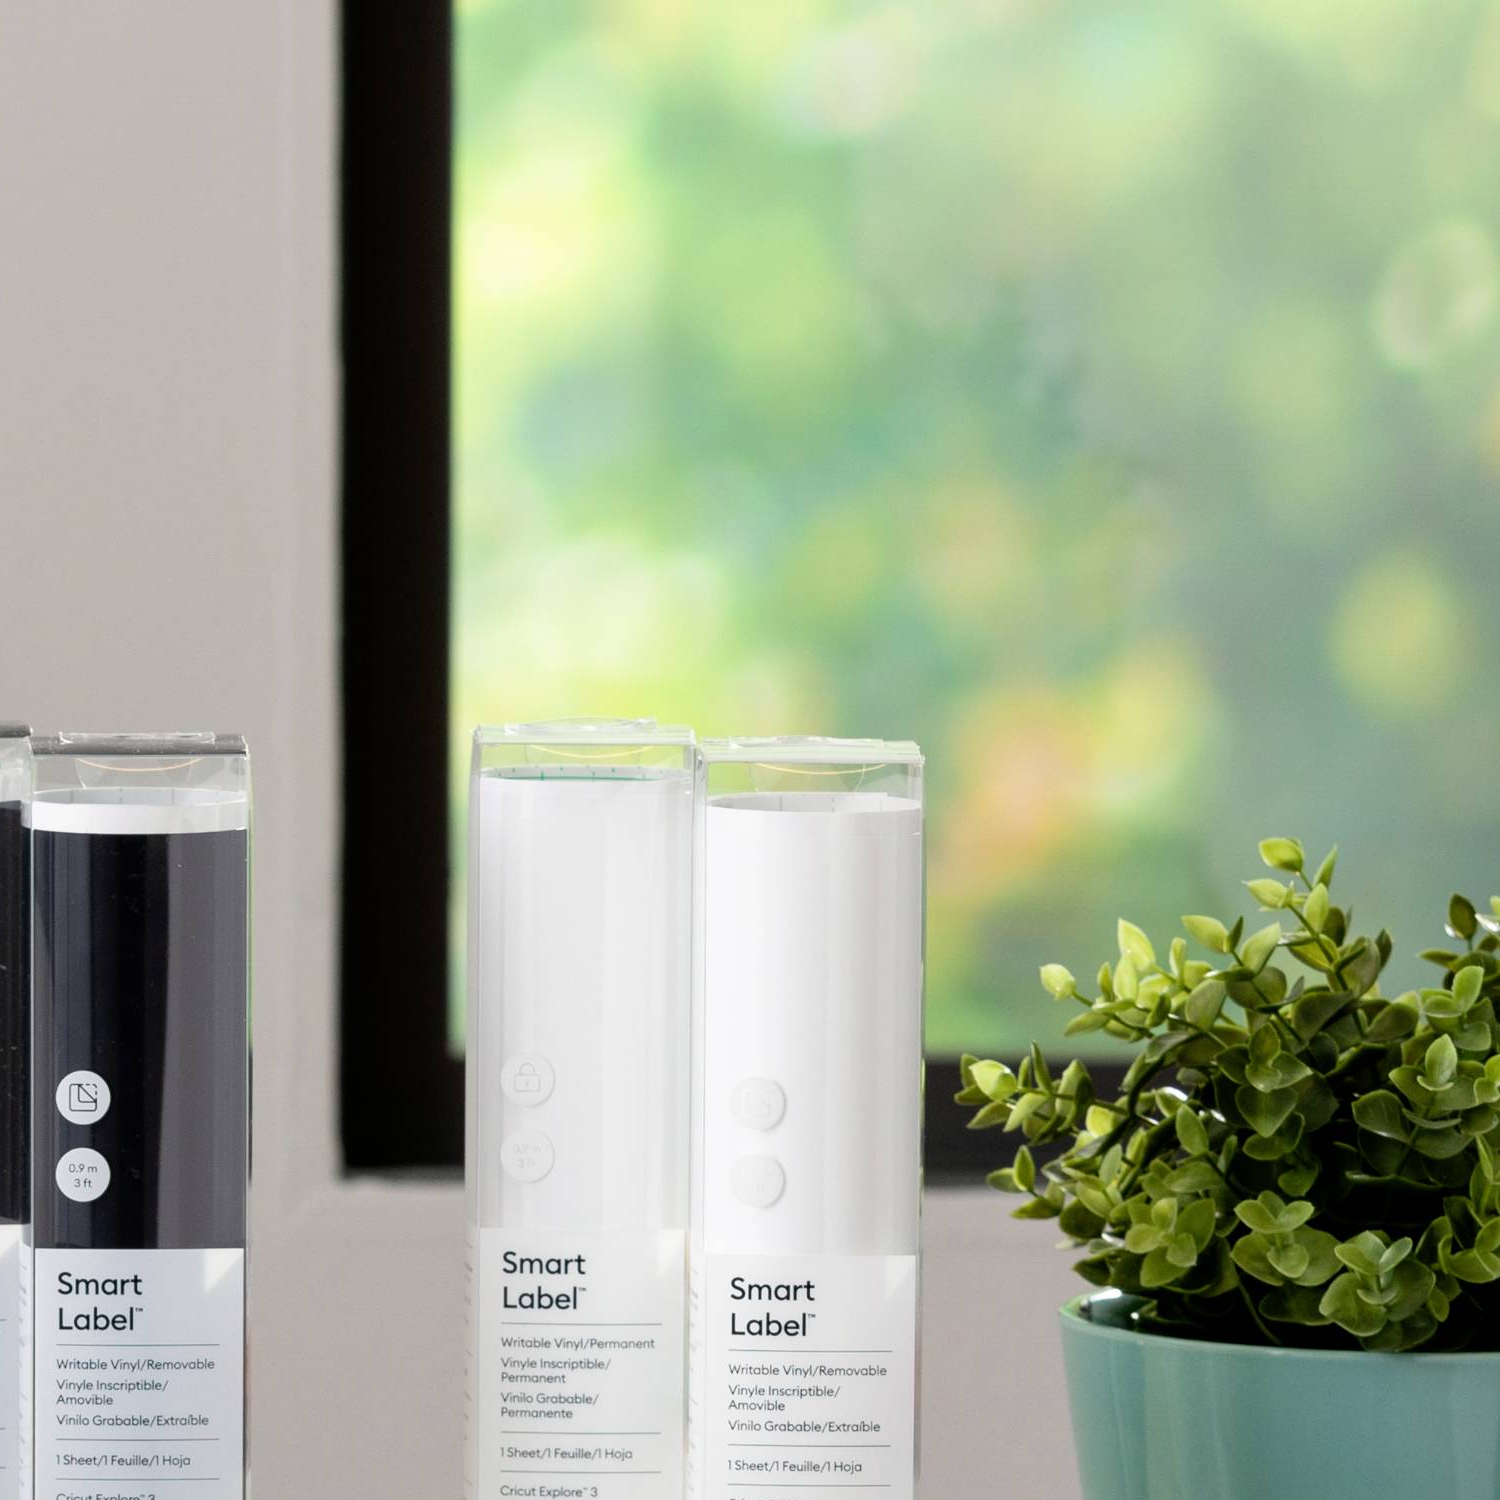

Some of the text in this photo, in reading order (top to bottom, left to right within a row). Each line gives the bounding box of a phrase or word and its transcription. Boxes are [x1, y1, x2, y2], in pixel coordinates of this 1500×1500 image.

[68, 1163, 85, 1173] 0.9
[74, 1178, 92, 1188] 3 ft
[502, 1251, 586, 1275] Smart
[57, 1272, 142, 1296] Smart
[730, 1277, 815, 1301] Smart
[501, 1337, 655, 1351] Writable Vinyl/Permanent
[56, 1358, 215, 1373] Writable Vinyl/Removable
[500, 1357, 611, 1372] Vinyle Inscriptible/
[501, 1372, 566, 1384] Permanent
[728, 1364, 887, 1379] Writable Vinyl/Removable
[56, 1379, 169, 1393] Vinyle Inscriptible/
[728, 1384, 841, 1399] Vinyle Inscriptible/
[56, 1394, 114, 1405] Amovible
[500, 1392, 599, 1405] Vinilo Grabable/
[728, 1399, 785, 1411] Amovible
[501, 1407, 573, 1419] Permanente
[56, 1414, 90, 1426] Vinilo
[728, 1420, 762, 1431] Vinilo
[162, 1454, 191, 1468] Hoja
[604, 1448, 633, 1461] Hoja
[834, 1461, 862, 1474] Hoja
